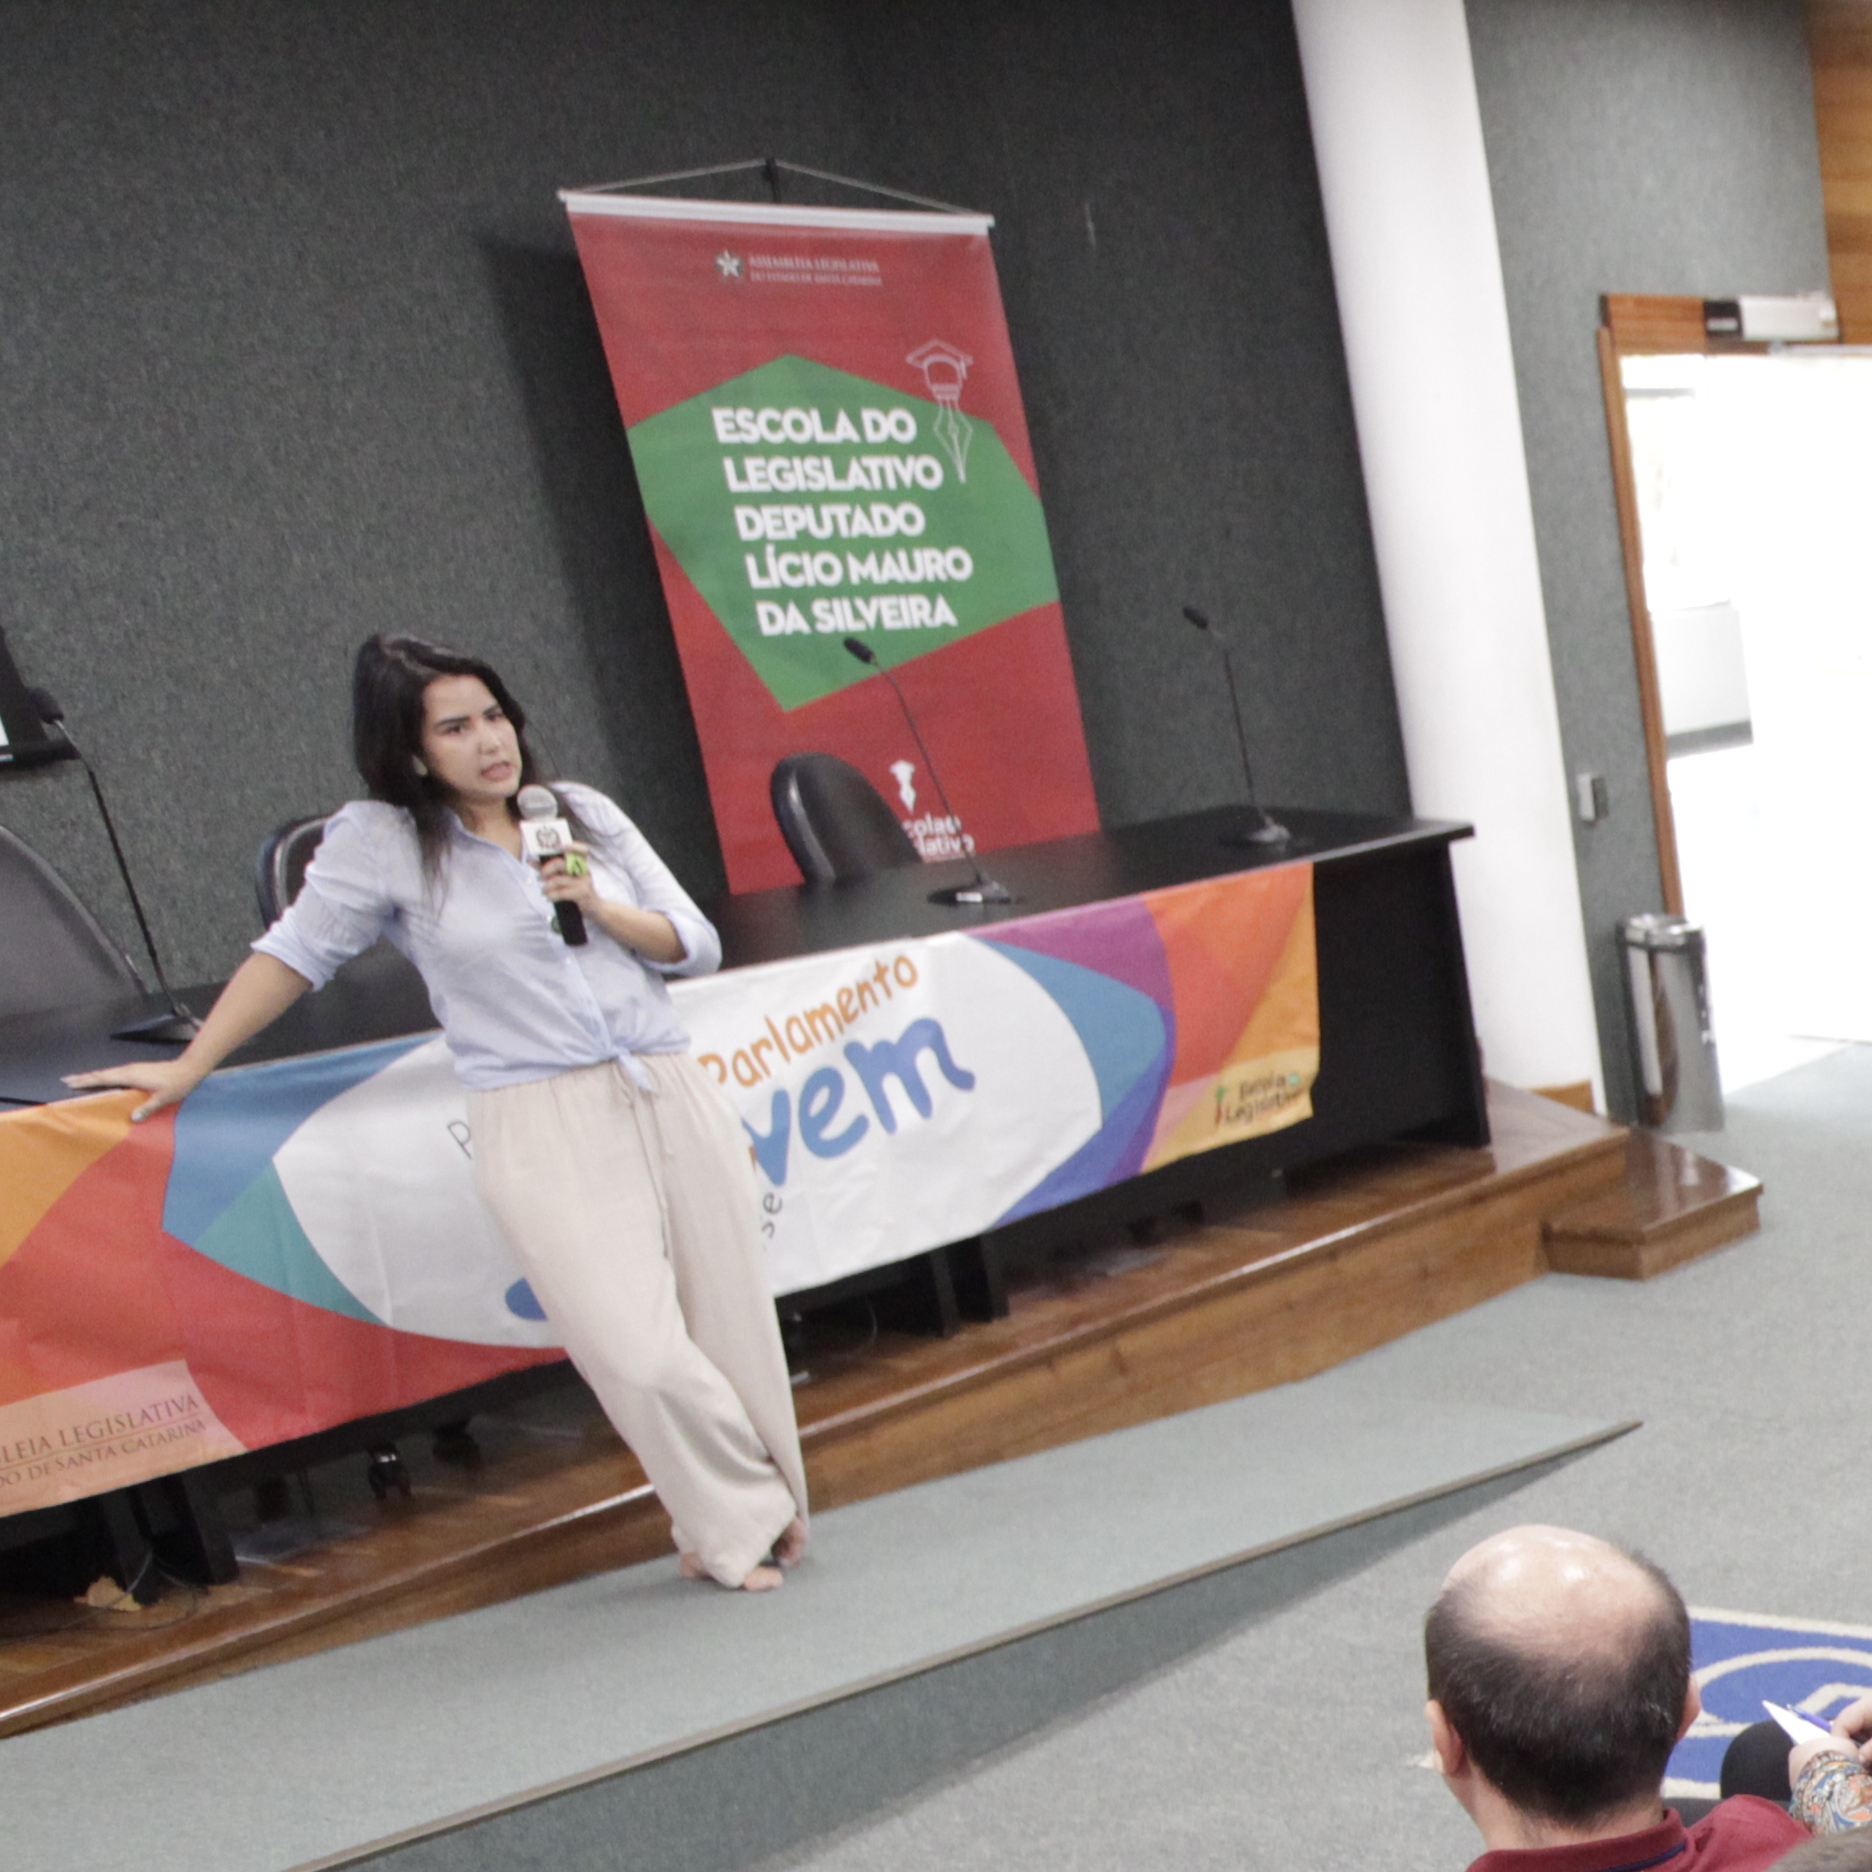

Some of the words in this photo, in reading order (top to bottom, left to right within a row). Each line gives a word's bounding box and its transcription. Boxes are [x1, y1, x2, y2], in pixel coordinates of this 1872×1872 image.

[711, 406, 863, 444] ESCOLA
[863, 407, 917, 444] DO
[723, 455, 944, 492] LEGISLATIVO
[734, 503, 926, 541] DEPUTADO
[745, 543, 844, 589] LÍCIO
[849, 547, 974, 585] MAURO
[756, 601, 811, 636] DA
[812, 594, 958, 634] SILVEIRA
[741, 1017, 976, 1187] vem
[58, 1394, 199, 1448] LEGISLATIVA
[28, 1461, 51, 1482] DE
[55, 1446, 118, 1471] SANTA
[121, 1418, 207, 1455] CATARINA
